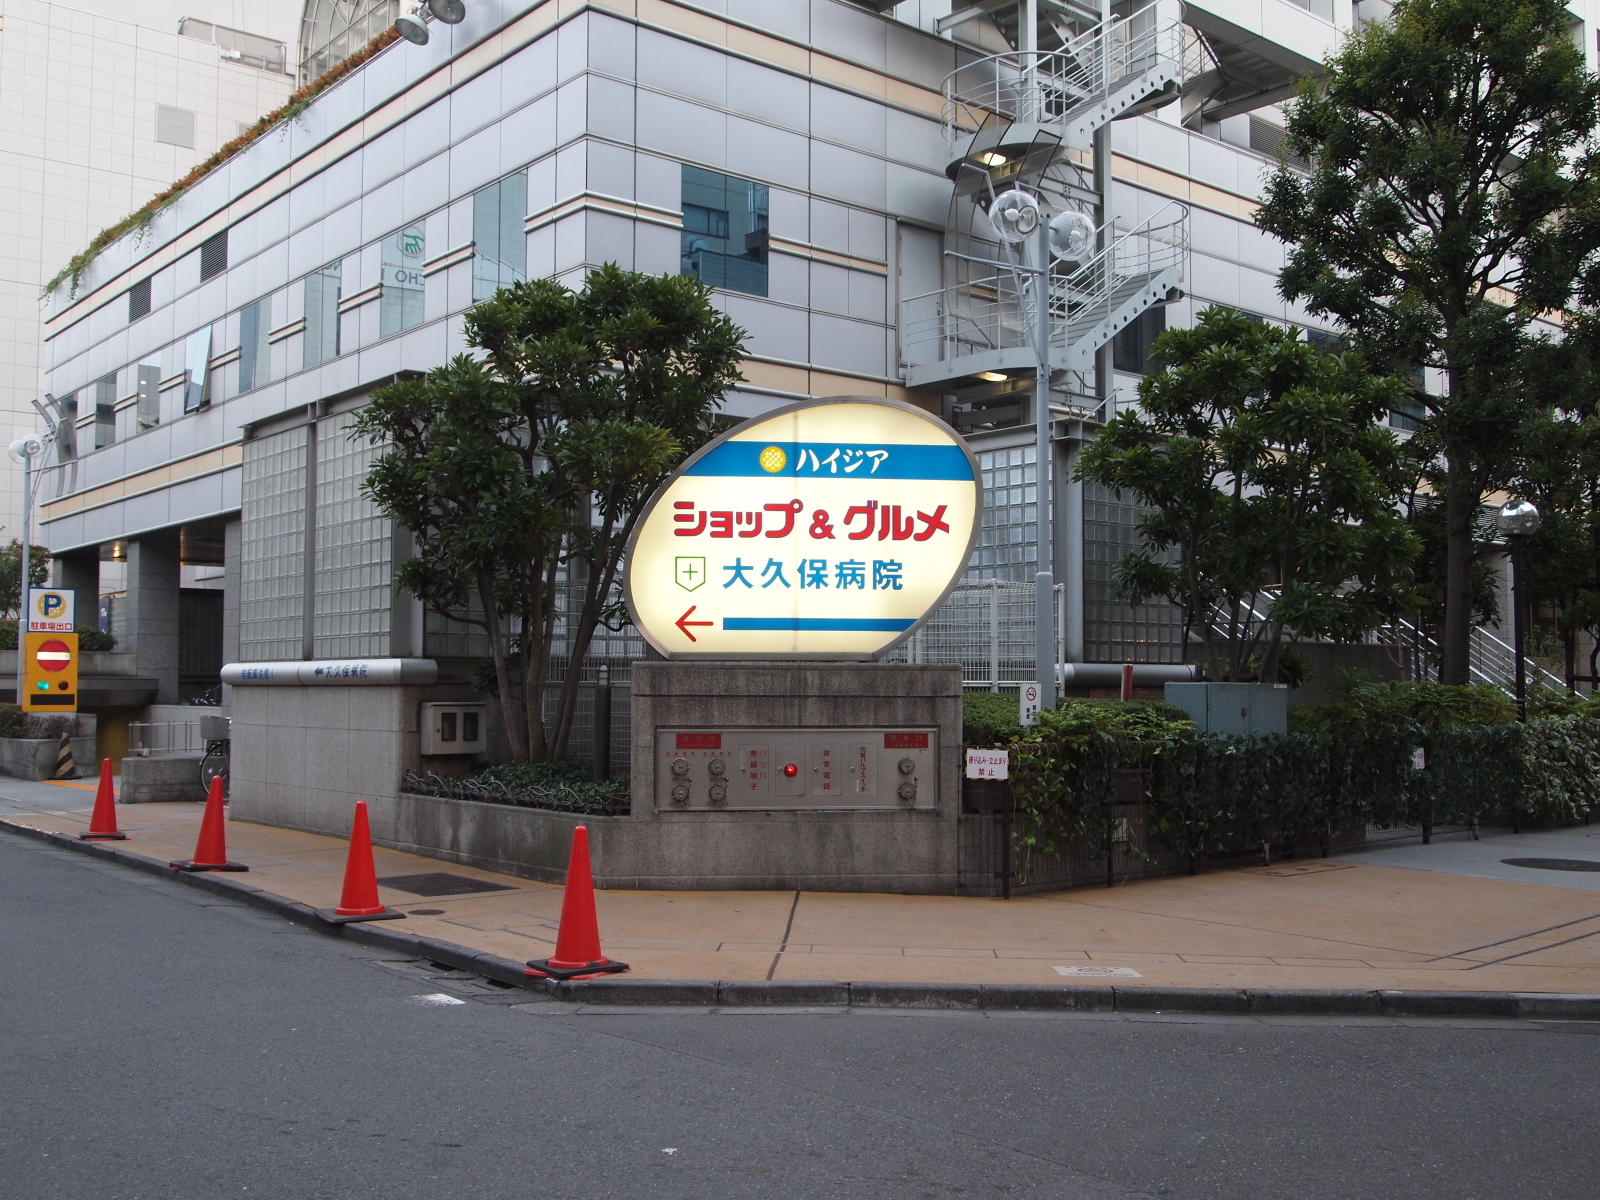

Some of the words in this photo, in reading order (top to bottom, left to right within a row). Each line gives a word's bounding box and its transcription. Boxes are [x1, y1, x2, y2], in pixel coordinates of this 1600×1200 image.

[795, 447, 889, 474] ハイジア
[722, 557, 904, 590] 大久保病院
[44, 594, 62, 616] P
[30, 621, 73, 631] 駐車場出口
[325, 663, 368, 678] 大久保病院
[822, 749, 831, 790] 非常電話
[978, 768, 995, 777] 禁止
